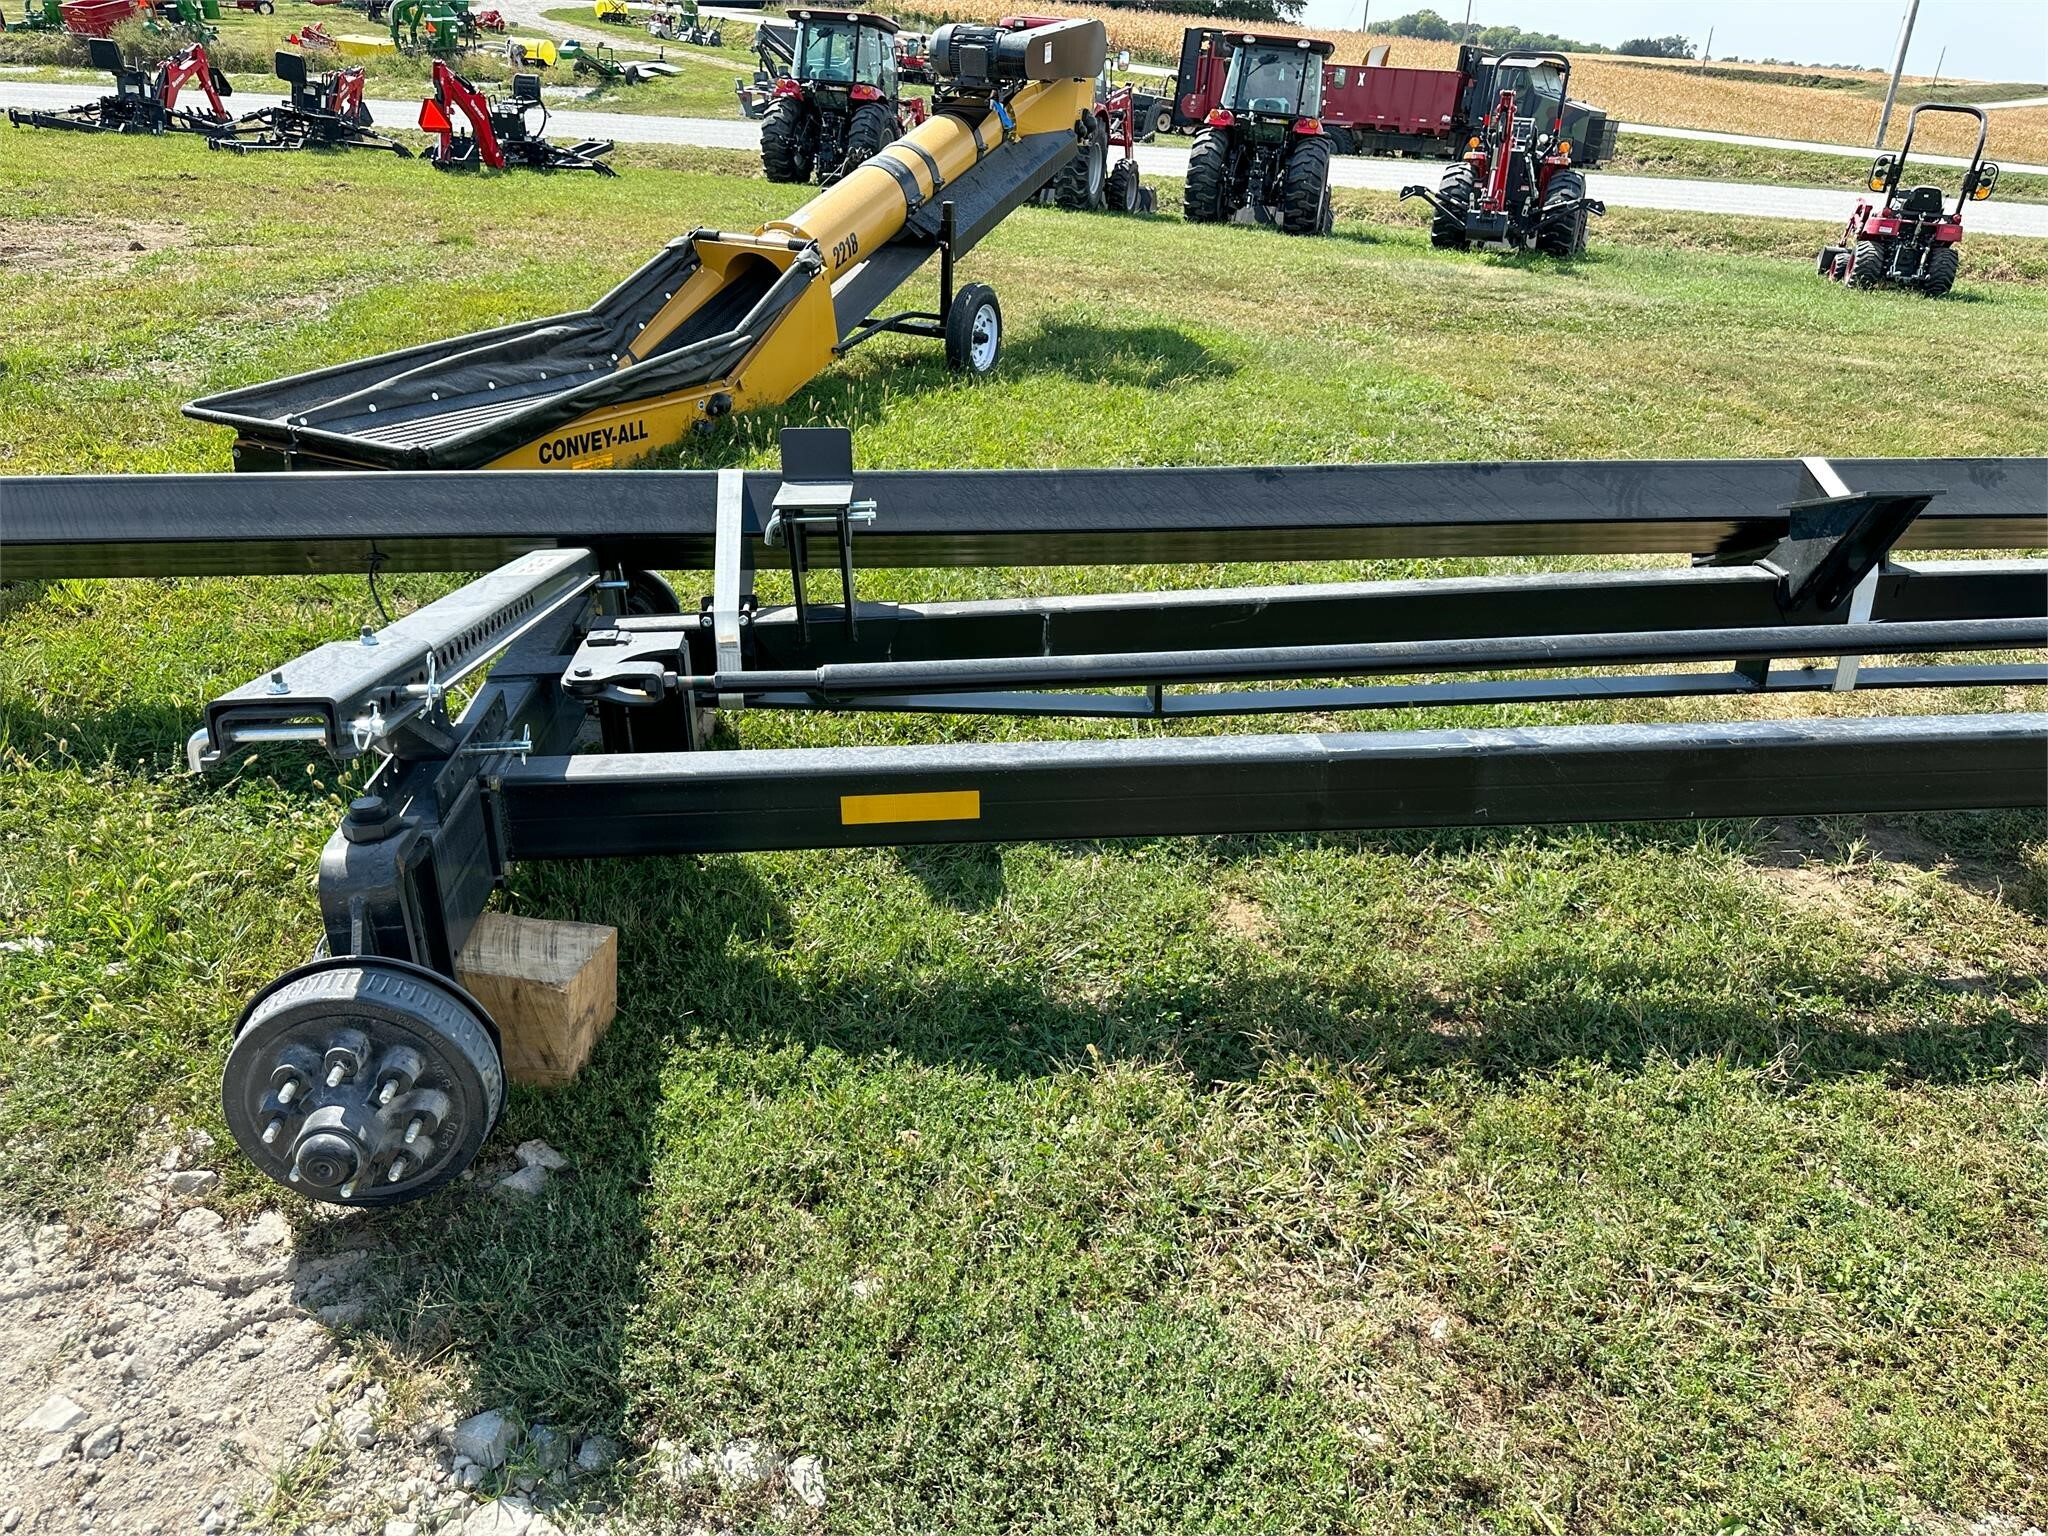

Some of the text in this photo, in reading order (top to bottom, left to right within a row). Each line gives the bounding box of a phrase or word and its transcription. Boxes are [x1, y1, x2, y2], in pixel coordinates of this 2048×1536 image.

[1357, 72, 1366, 87] X
[833, 232, 858, 270] 2218
[538, 420, 648, 465] CONVEY-ALL
